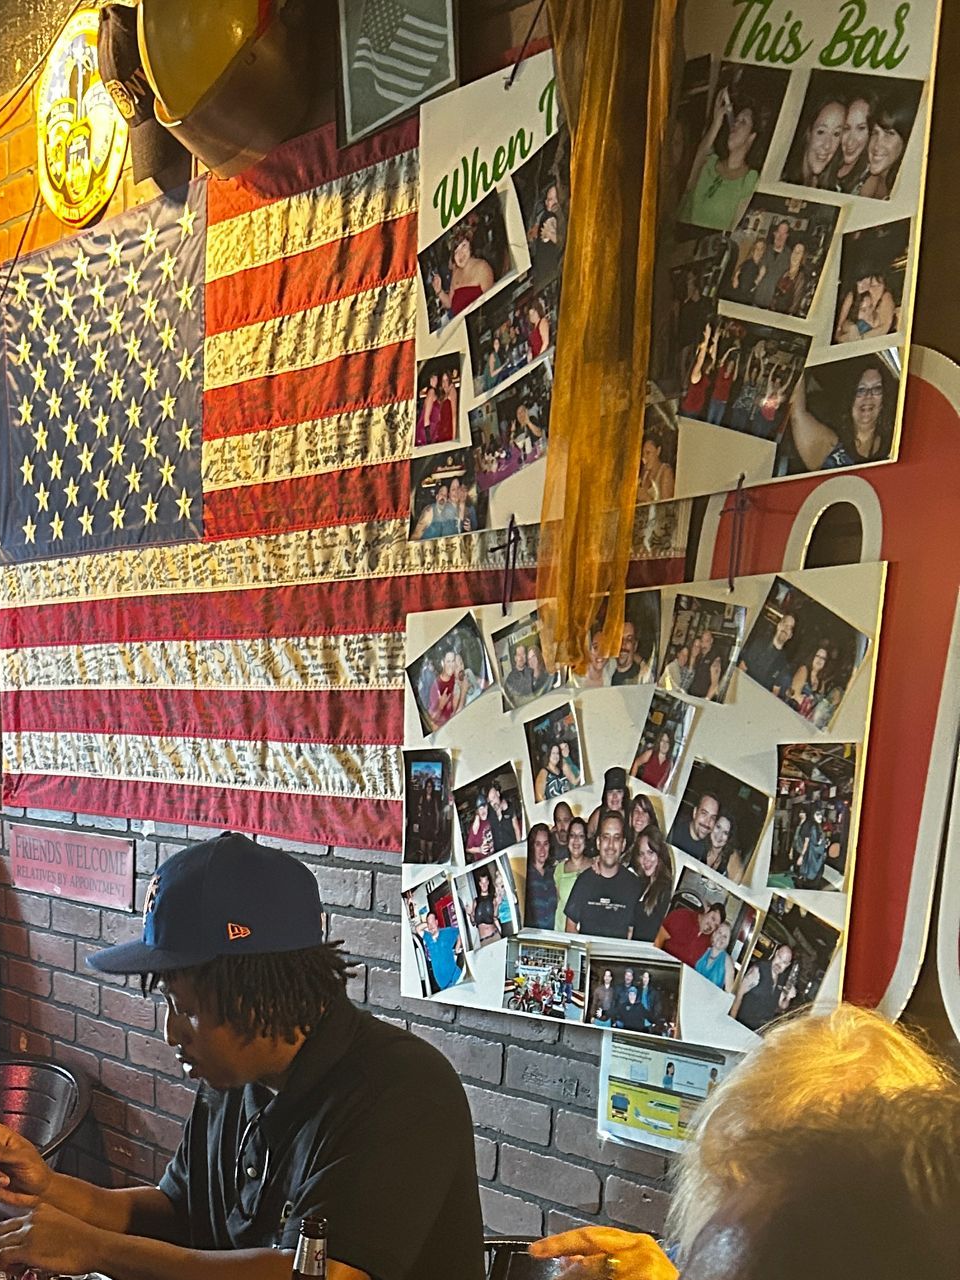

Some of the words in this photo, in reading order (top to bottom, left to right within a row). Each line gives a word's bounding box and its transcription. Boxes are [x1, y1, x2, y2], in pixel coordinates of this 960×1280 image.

[723, 0, 814, 64] This
[818, 0, 911, 70] Bar
[433, 127, 534, 229] When
[15, 834, 62, 865] FRIENDS
[63, 842, 128, 877] WELCOME
[15, 863, 59, 884] RELATIVES
[56, 872, 69, 886] BY
[69, 875, 126, 898] APPOINTMENT
